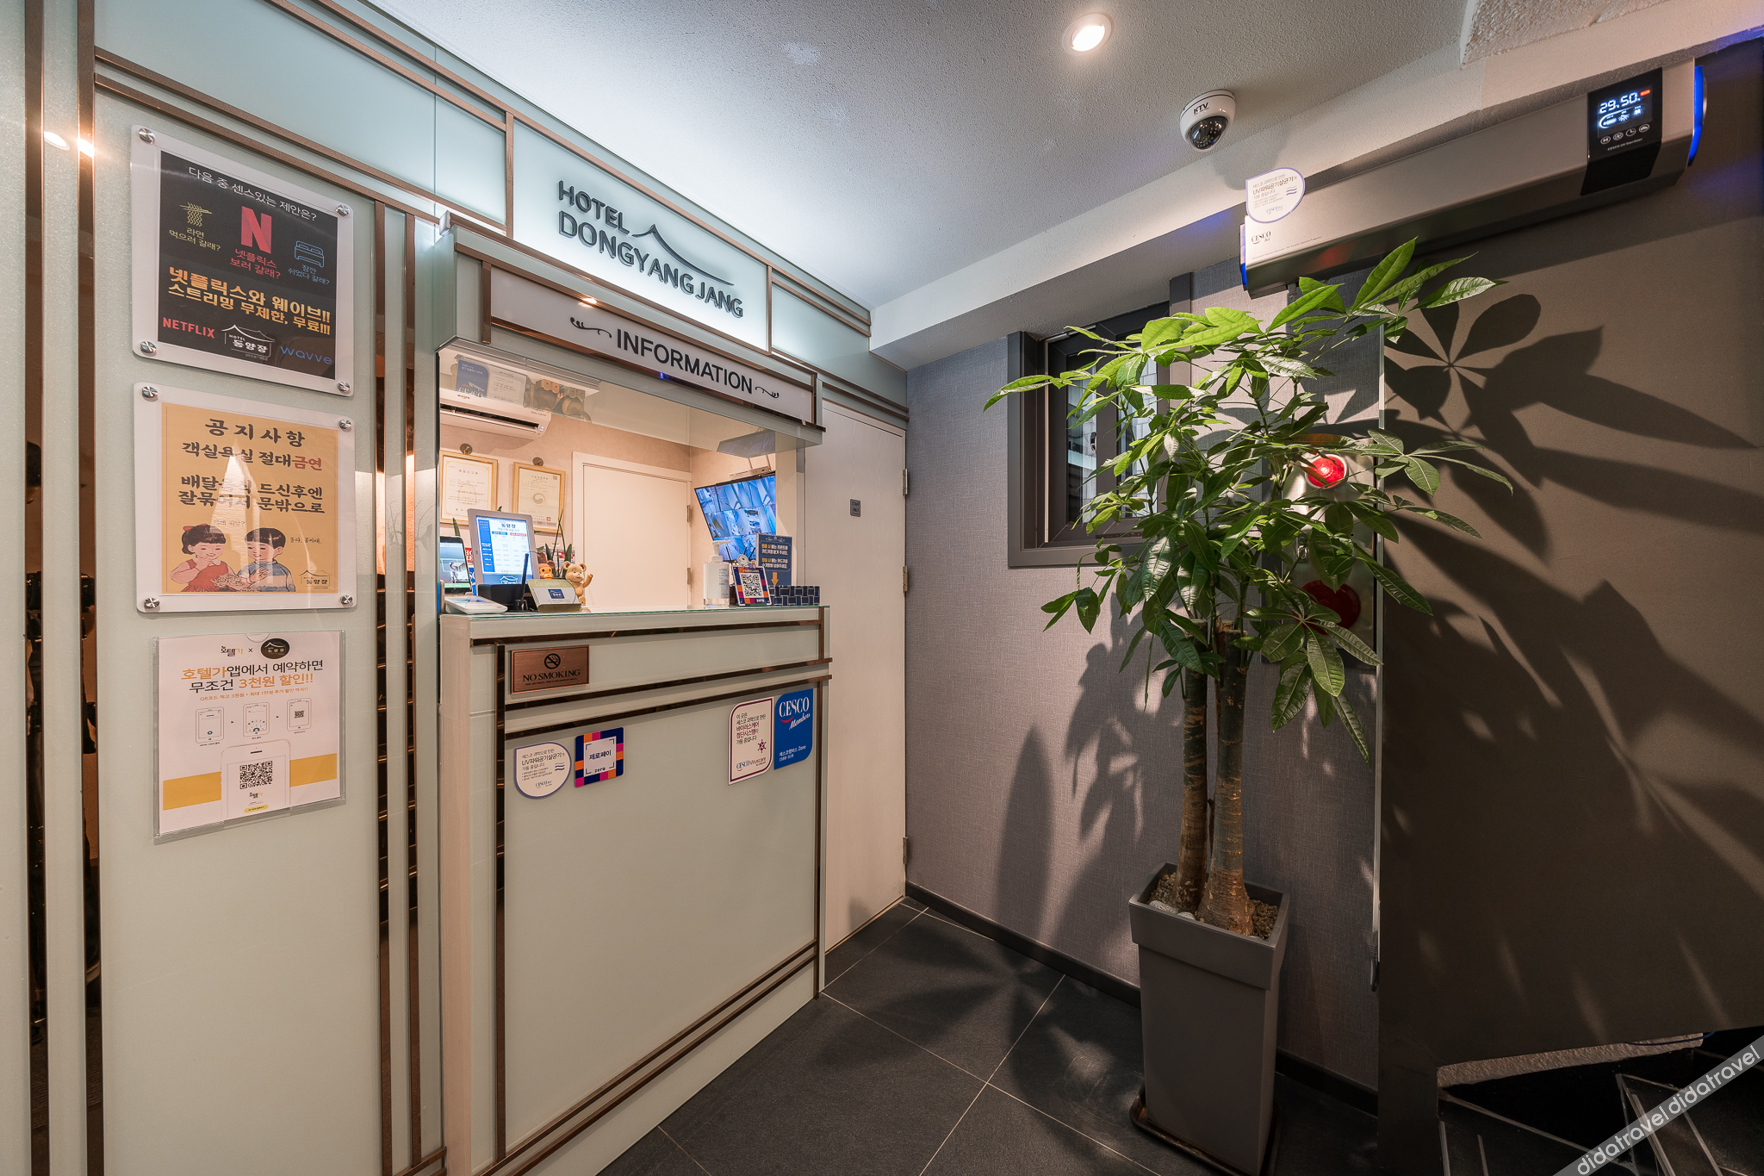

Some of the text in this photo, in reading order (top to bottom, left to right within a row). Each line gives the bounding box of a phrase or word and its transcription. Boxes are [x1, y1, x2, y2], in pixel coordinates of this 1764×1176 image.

[1193, 102, 1209, 115] KTV
[188, 166, 317, 221] 다음 중 센스있는 제안은?
[558, 180, 630, 235] HOTEL
[241, 205, 272, 254] N
[1251, 230, 1272, 243] CESCO
[198, 238, 222, 252] 갈래?
[230, 257, 281, 280] 보러 갈래?
[235, 249, 277, 269] 넷플릭스
[311, 274, 330, 286] 갈래?
[169, 266, 330, 324] 넷플릭스와 웨이브!!
[168, 283, 330, 336] 스트리밍 무제한, 무료!!!
[162, 317, 216, 340] NETFLIX
[232, 339, 269, 354] 동양장
[280, 345, 332, 365] wavve
[616, 328, 752, 395] INFORMATION
[256, 496, 326, 514] 문밖으로
[257, 482, 323, 511] 드신후엔
[220, 645, 244, 658] 호텔가
[181, 659, 324, 680] 호텔가앱에서 예약하면
[522, 673, 537, 683] NO
[538, 669, 581, 681] SMOKING
[189, 673, 314, 694] 무조건 3천원 할인!!
[778, 697, 810, 718] CESCO
[788, 713, 811, 731] Members
[588, 749, 612, 761] 제로페이
